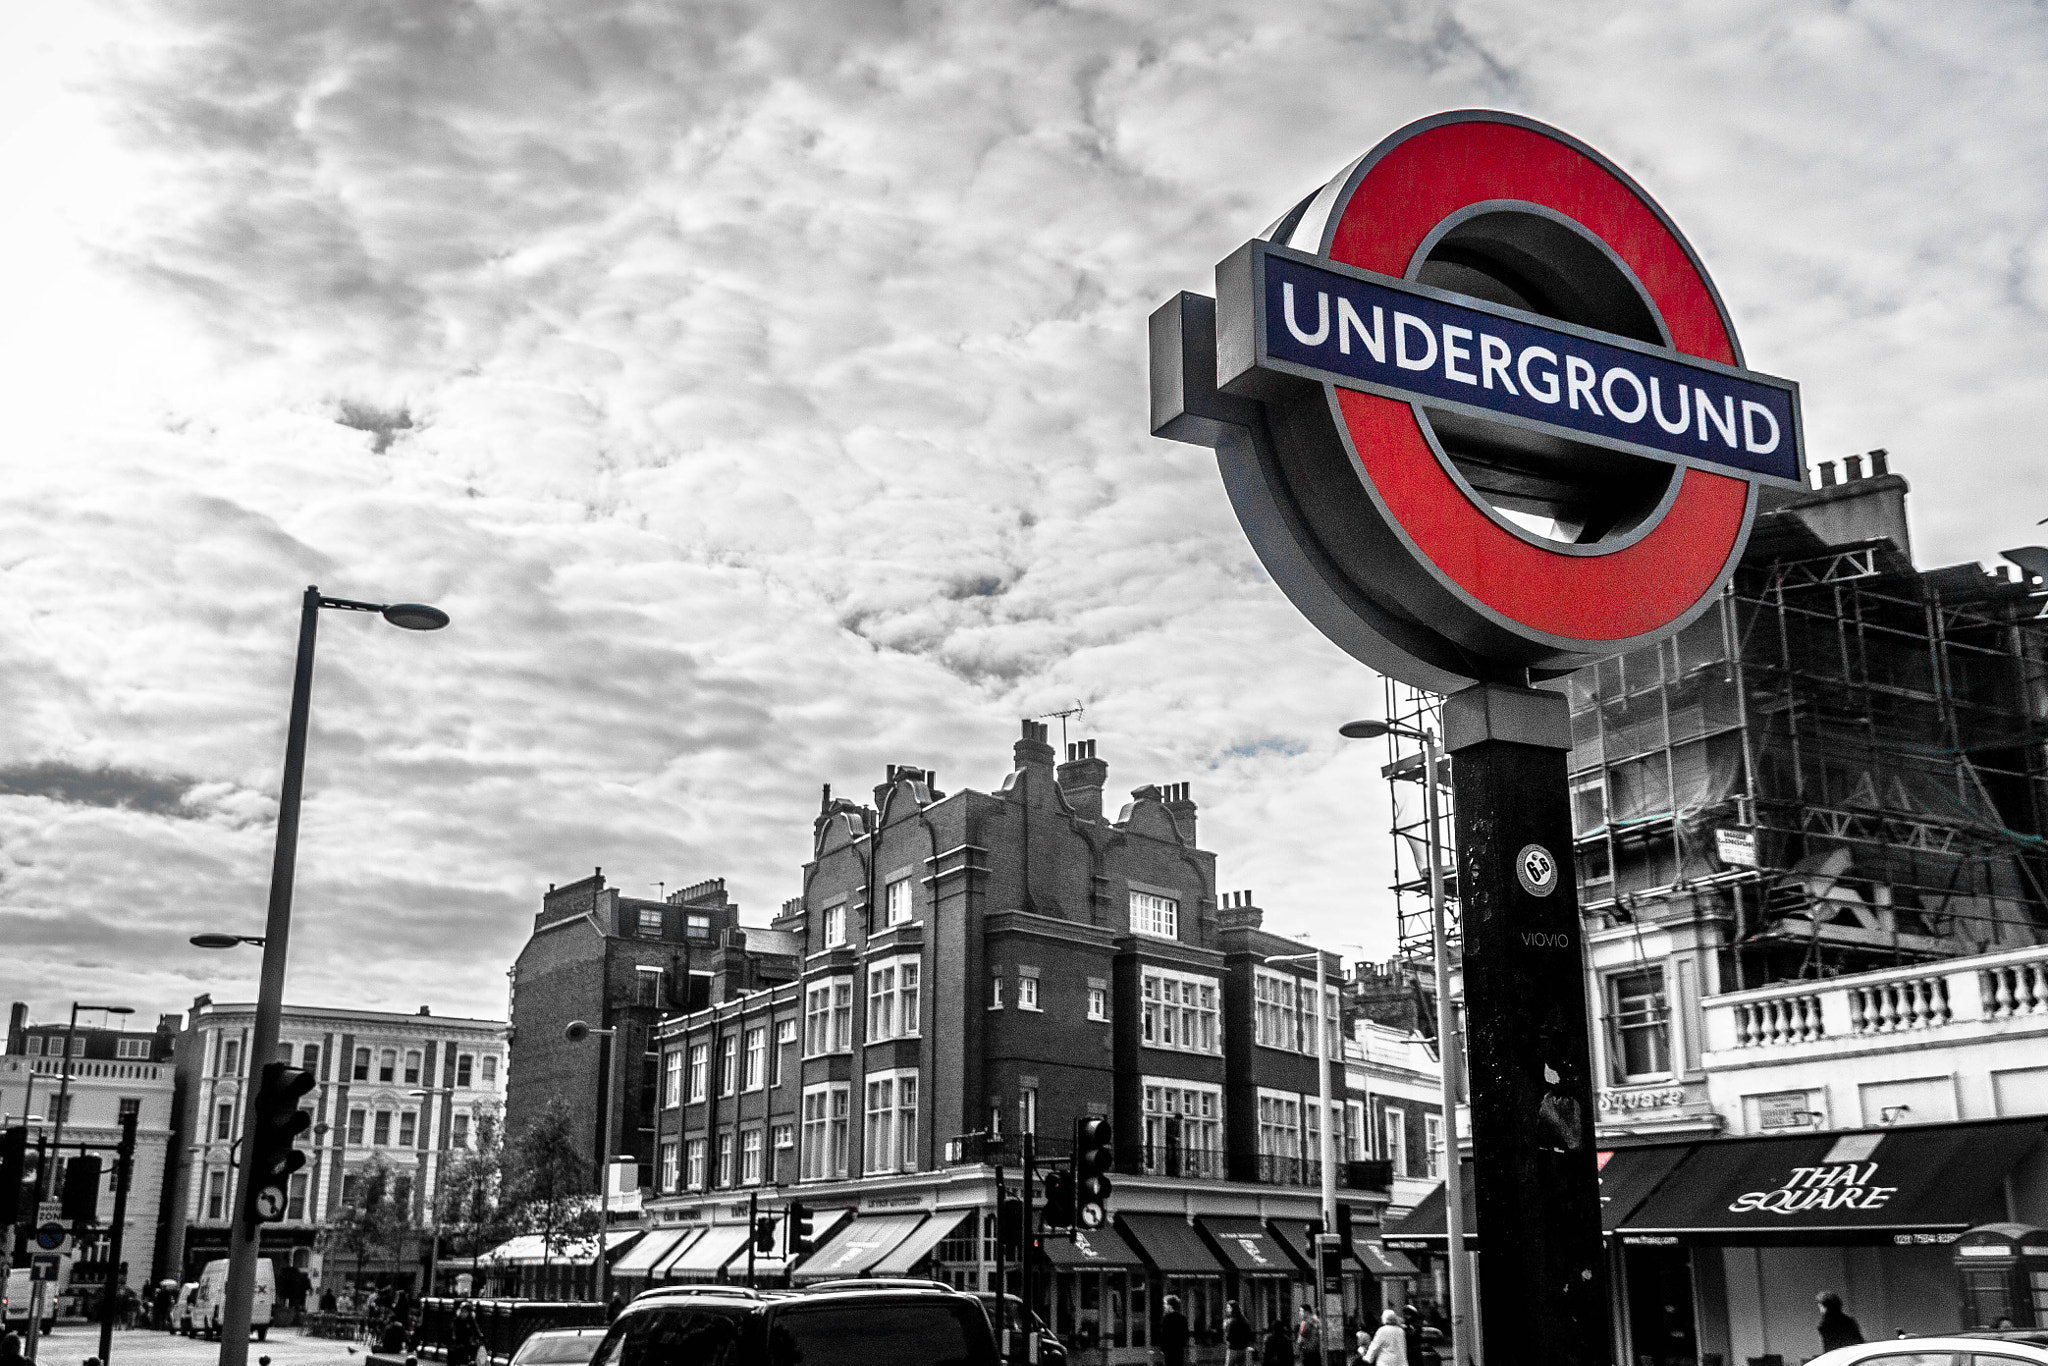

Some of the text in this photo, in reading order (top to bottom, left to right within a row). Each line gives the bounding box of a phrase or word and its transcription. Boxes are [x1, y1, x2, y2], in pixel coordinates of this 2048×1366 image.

[1282, 282, 1781, 455] UNDERGROUND
[1520, 931, 1569, 948] VIOVIO
[1780, 1161, 1879, 1190] THAI
[1728, 1186, 1899, 1215] SQUARE
